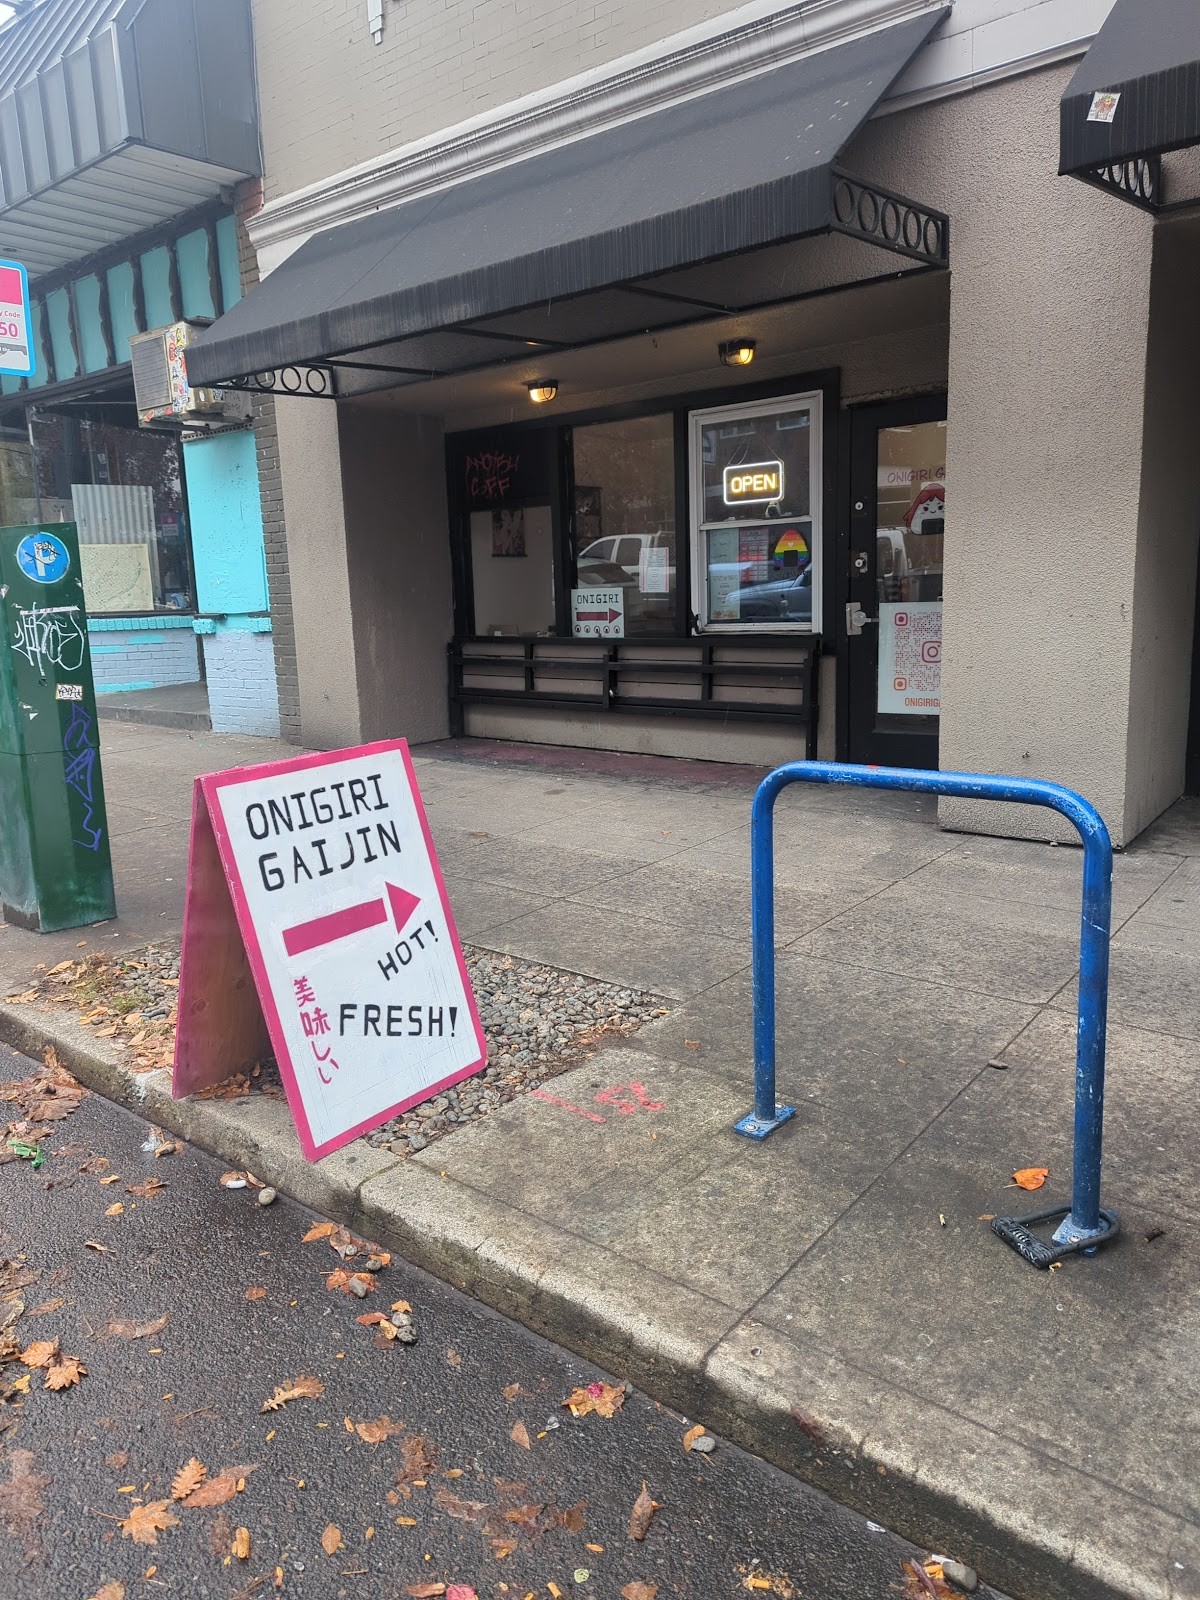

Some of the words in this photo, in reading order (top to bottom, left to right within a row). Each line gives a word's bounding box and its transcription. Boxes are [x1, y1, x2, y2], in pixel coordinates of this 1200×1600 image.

[731, 473, 776, 493] OPEN
[887, 469, 931, 483] ONIGIRI
[577, 594, 619, 604] ONIGIRI
[245, 773, 389, 840] ONIGIRI
[258, 820, 402, 892] GAIJIN
[377, 919, 438, 981] HOT!
[293, 976, 339, 1084] 美味しい
[339, 1003, 458, 1038] FRESH!
